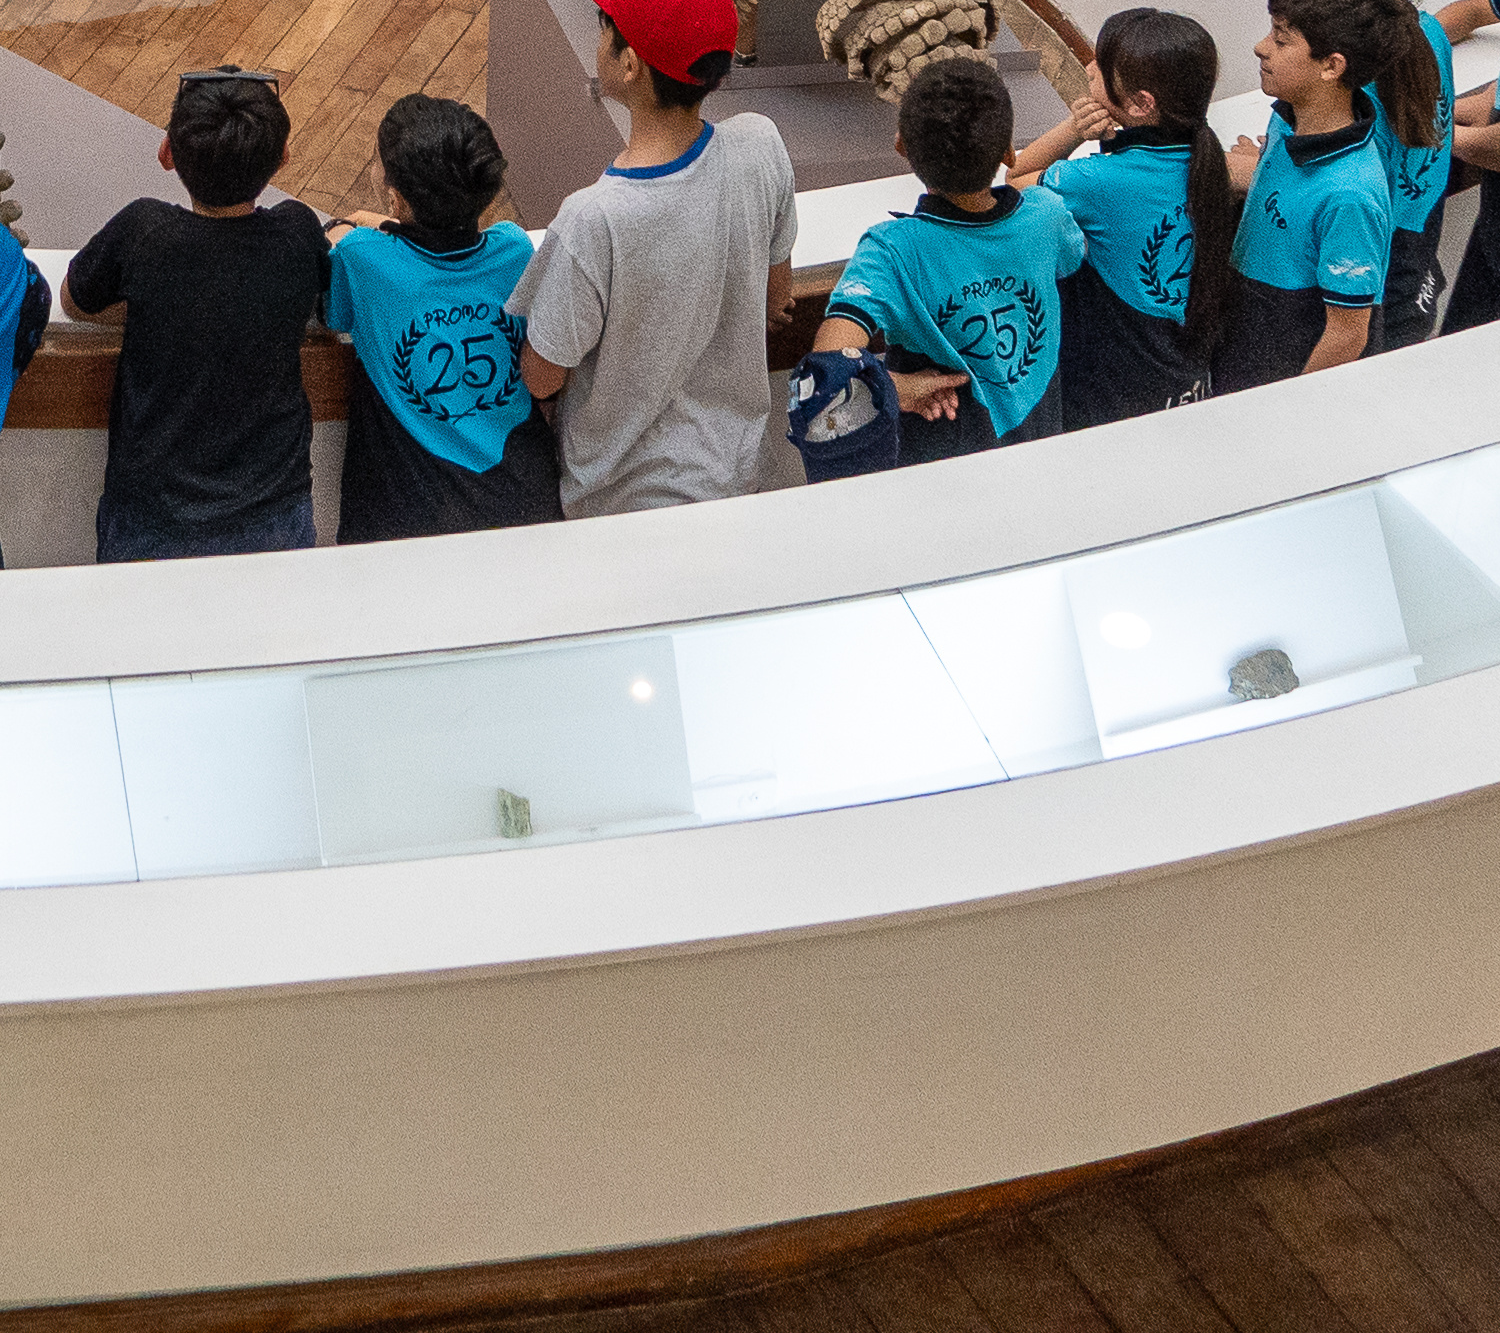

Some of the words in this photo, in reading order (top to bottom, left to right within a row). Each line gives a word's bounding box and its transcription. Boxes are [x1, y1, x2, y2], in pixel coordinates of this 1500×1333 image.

[1165, 231, 1195, 284] 2
[961, 276, 1017, 302] PROMO
[423, 302, 492, 331] PROMO
[961, 304, 1018, 364] 25
[425, 334, 498, 396] 25
